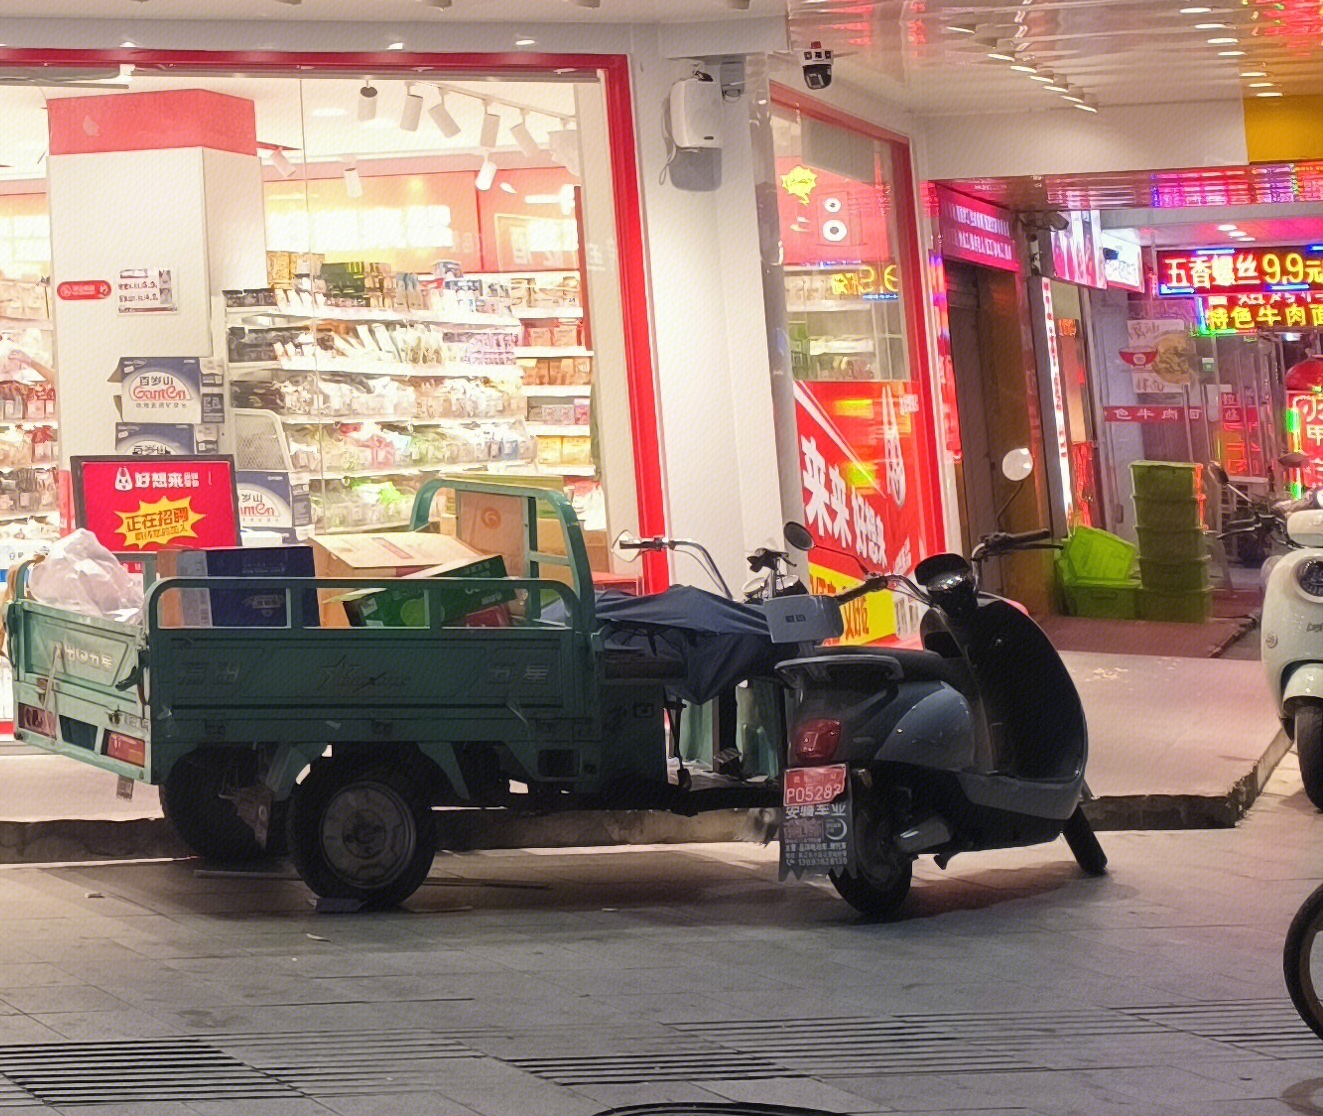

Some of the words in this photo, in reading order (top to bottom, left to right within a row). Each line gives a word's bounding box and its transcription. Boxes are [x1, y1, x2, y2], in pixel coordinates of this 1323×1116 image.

[1104, 407, 1203, 421] 色牛肉面
[134, 471, 184, 489] 好想来
